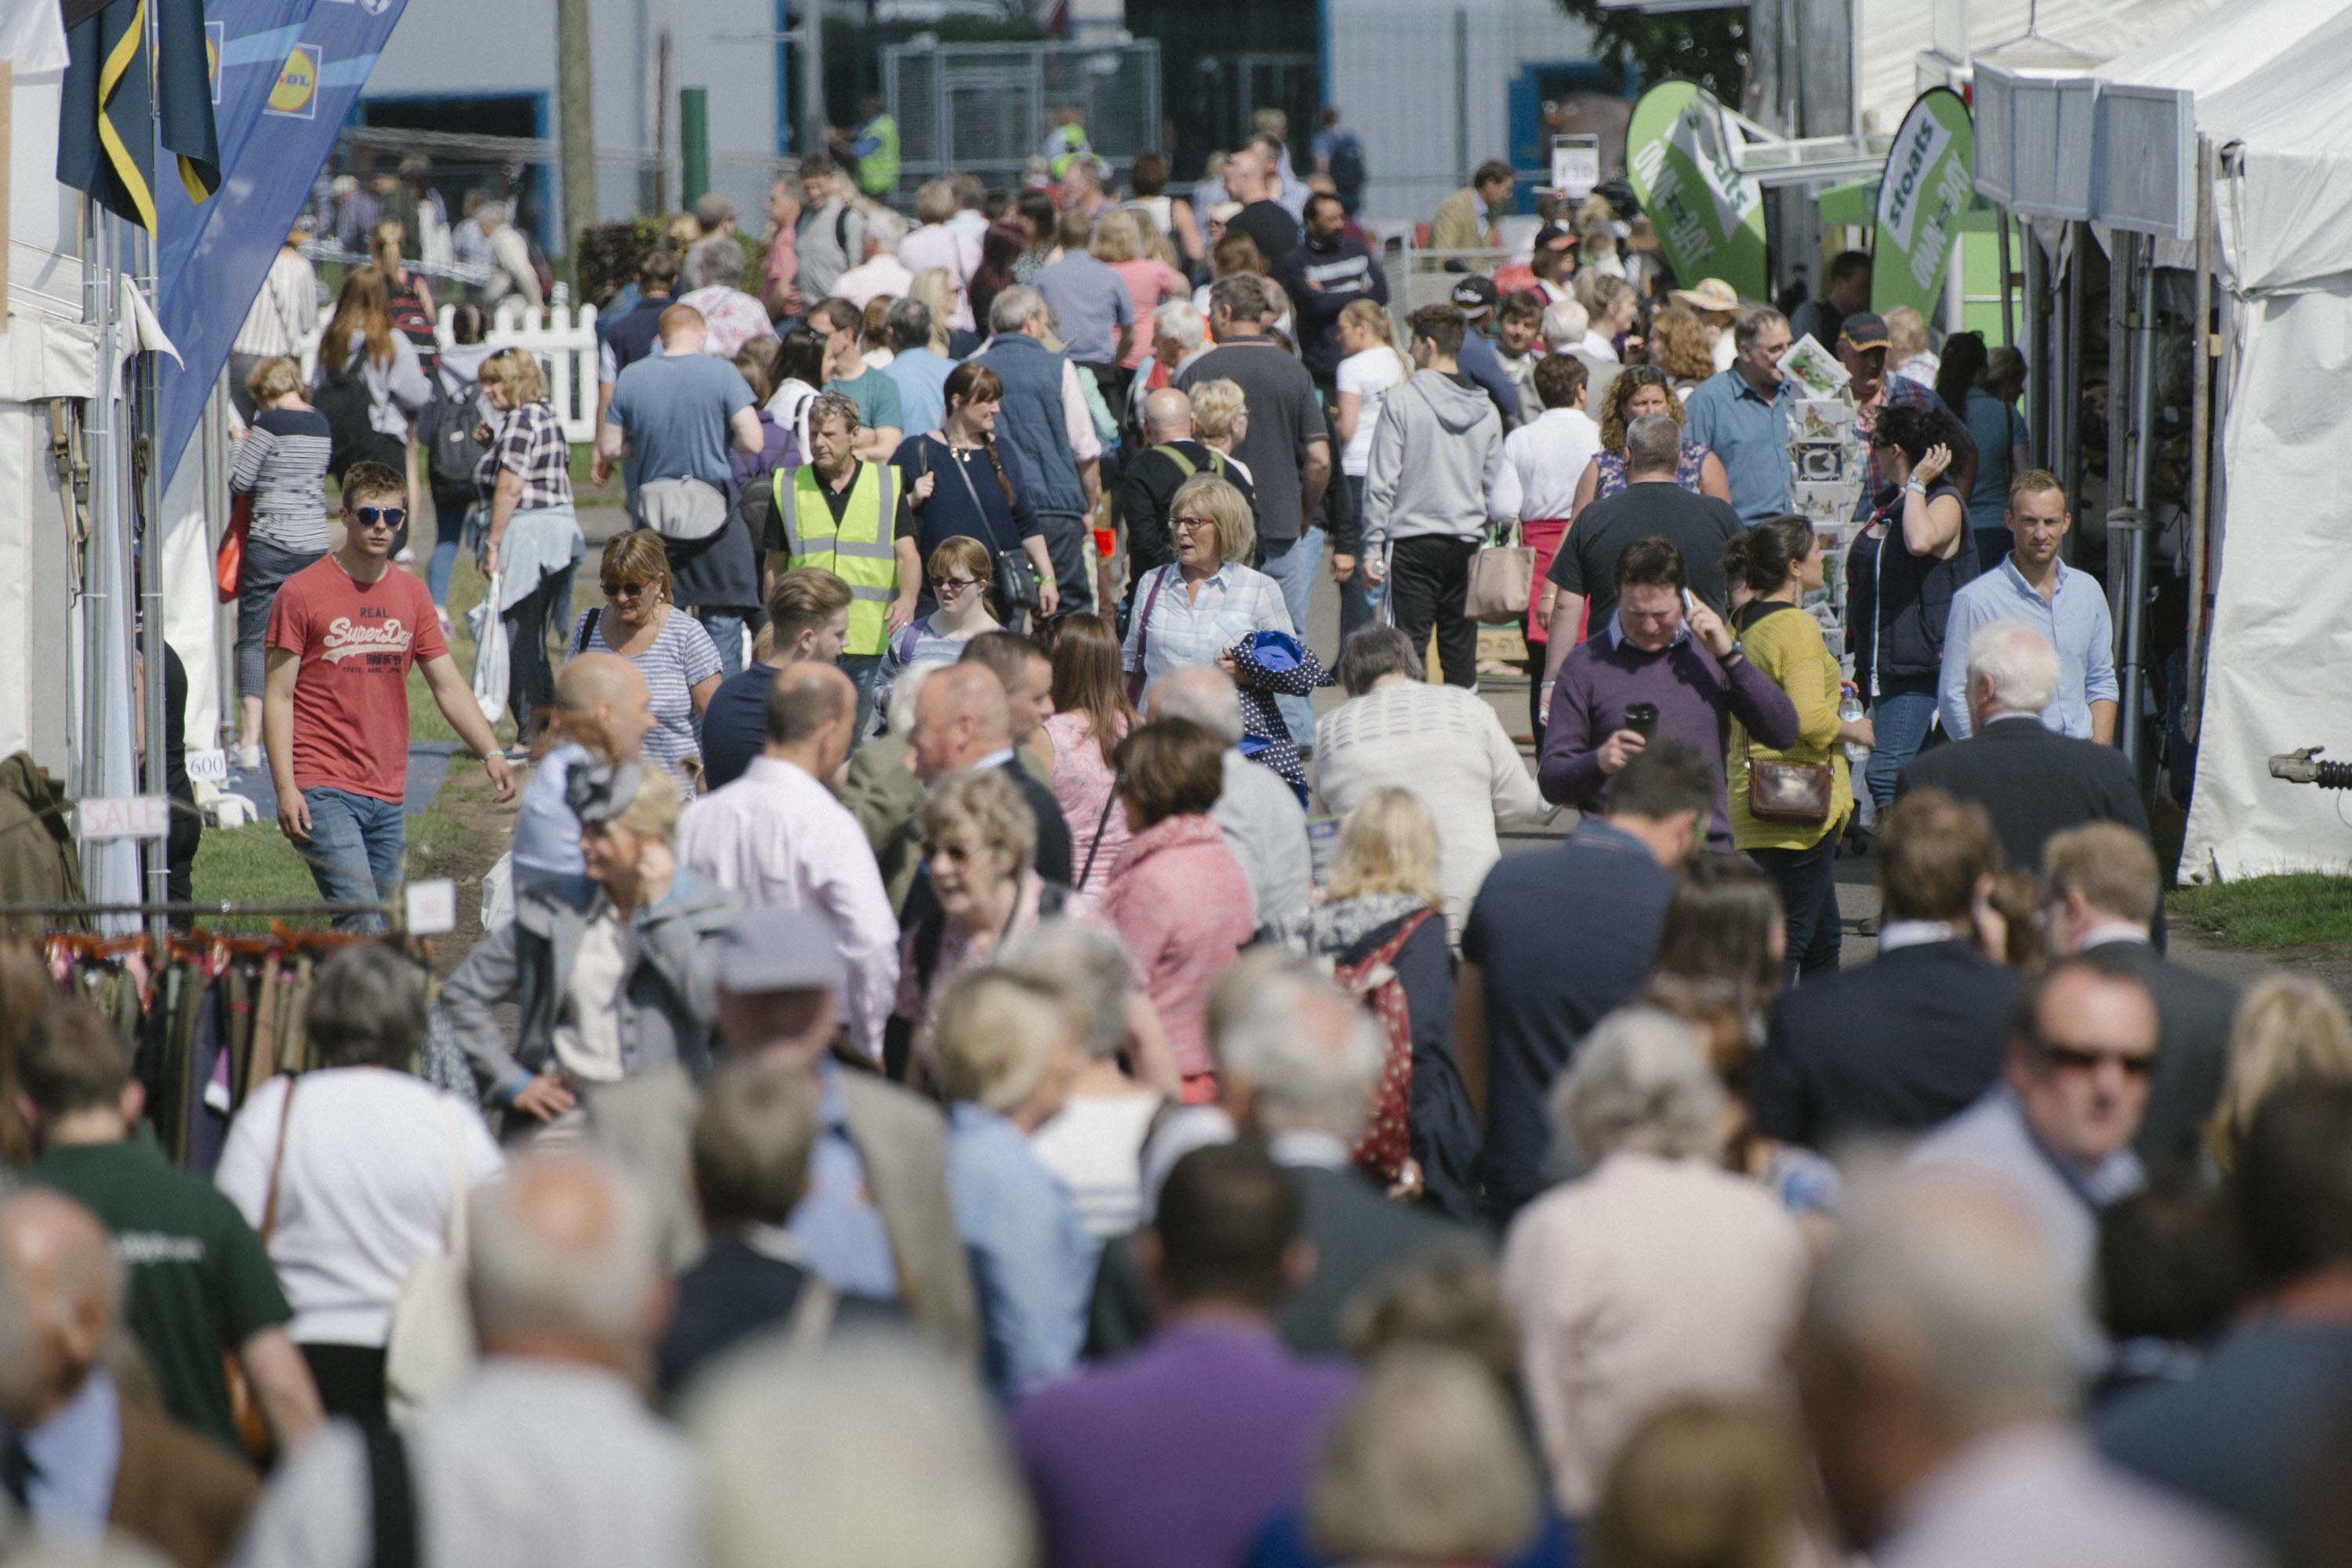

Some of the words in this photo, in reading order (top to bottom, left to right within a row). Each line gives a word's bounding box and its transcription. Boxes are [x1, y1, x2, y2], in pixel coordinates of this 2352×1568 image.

[1889, 117, 1934, 228] stoats
[360, 608, 389, 618] REAL
[191, 756, 223, 775] 600
[85, 800, 164, 833] SALE
